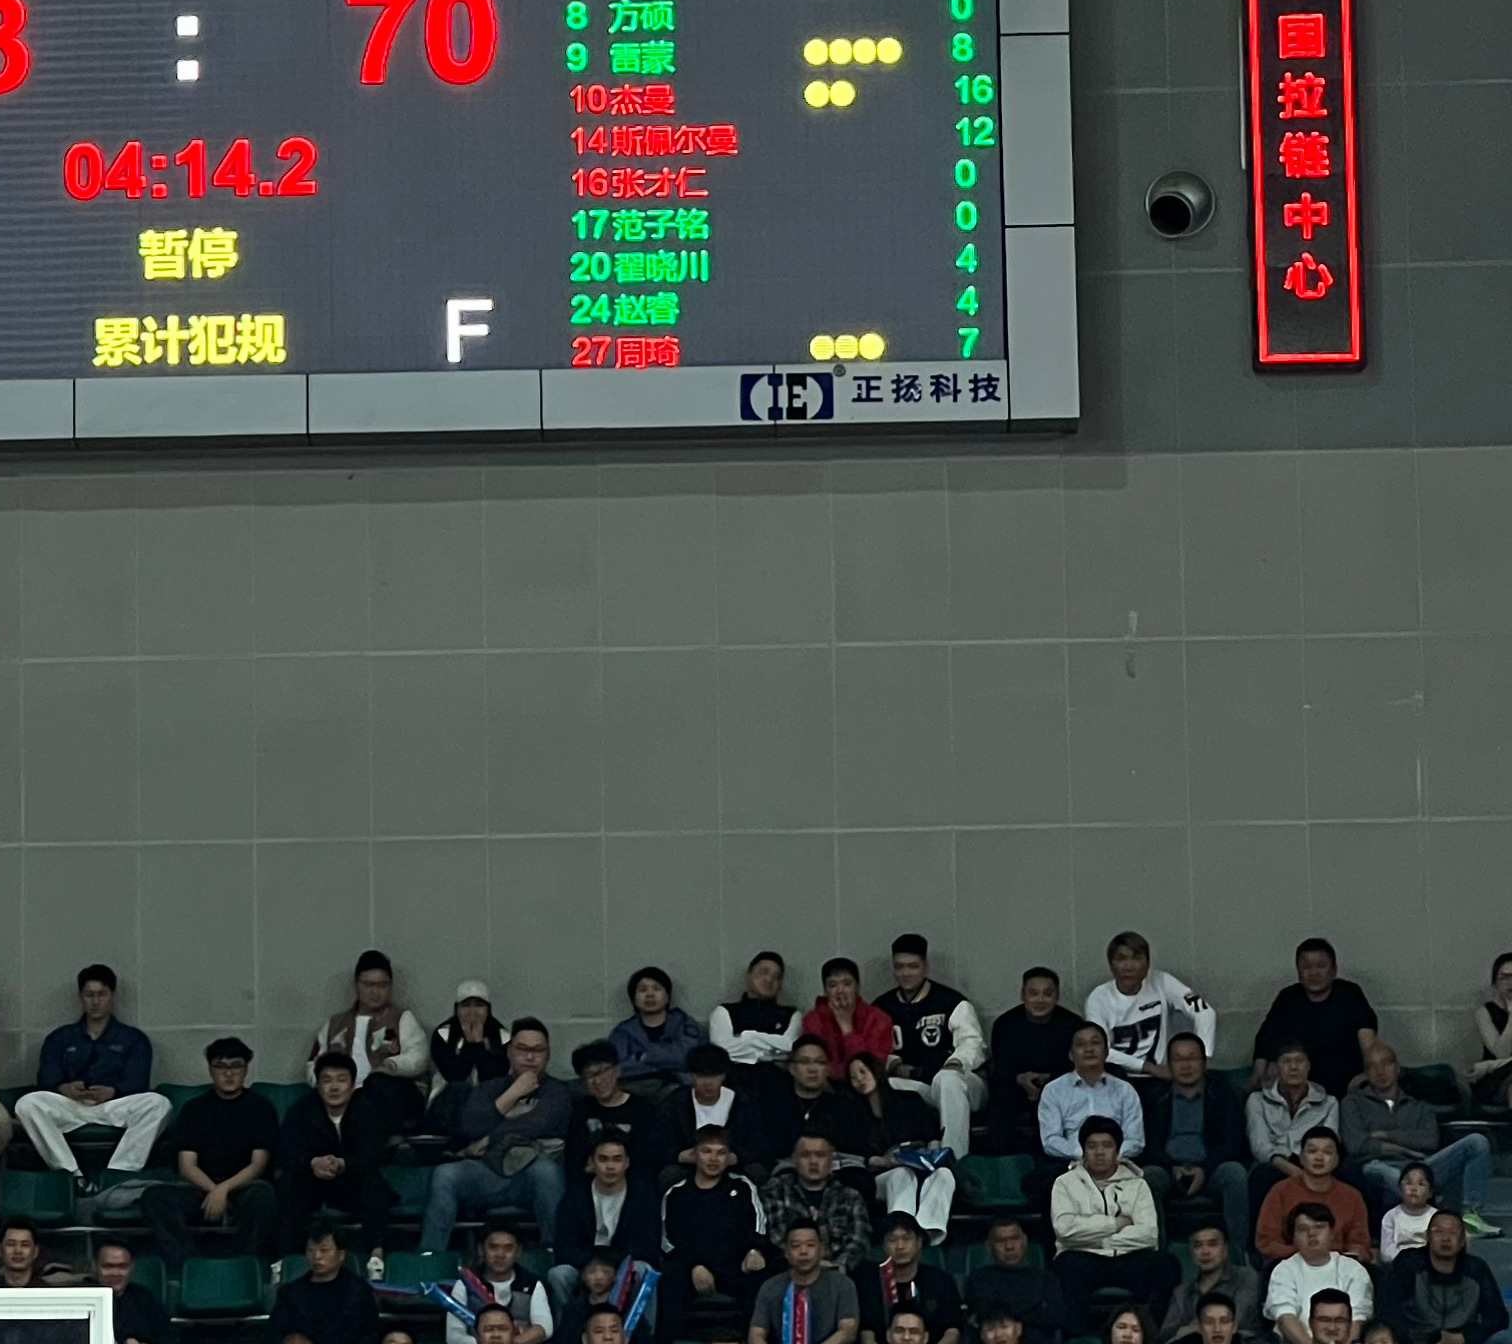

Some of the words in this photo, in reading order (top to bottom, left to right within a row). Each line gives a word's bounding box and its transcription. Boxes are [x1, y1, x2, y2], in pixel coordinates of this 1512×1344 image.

[565, 0, 590, 30] 8
[564, 42, 590, 73] 9
[609, 39, 676, 76] 雷蒙
[949, 32, 976, 63] 8
[954, 74, 994, 107] 16
[955, 115, 996, 148] 12
[62, 137, 319, 201] 04:14.2
[953, 159, 979, 190] 0
[954, 199, 979, 231] 0
[138, 227, 240, 280] 暂停
[955, 243, 979, 274] 4
[955, 285, 979, 316] 4
[93, 314, 287, 367] 累计犯规
[447, 300, 492, 362] F
[957, 328, 980, 358] 7
[852, 373, 1001, 403] 正扬科技
